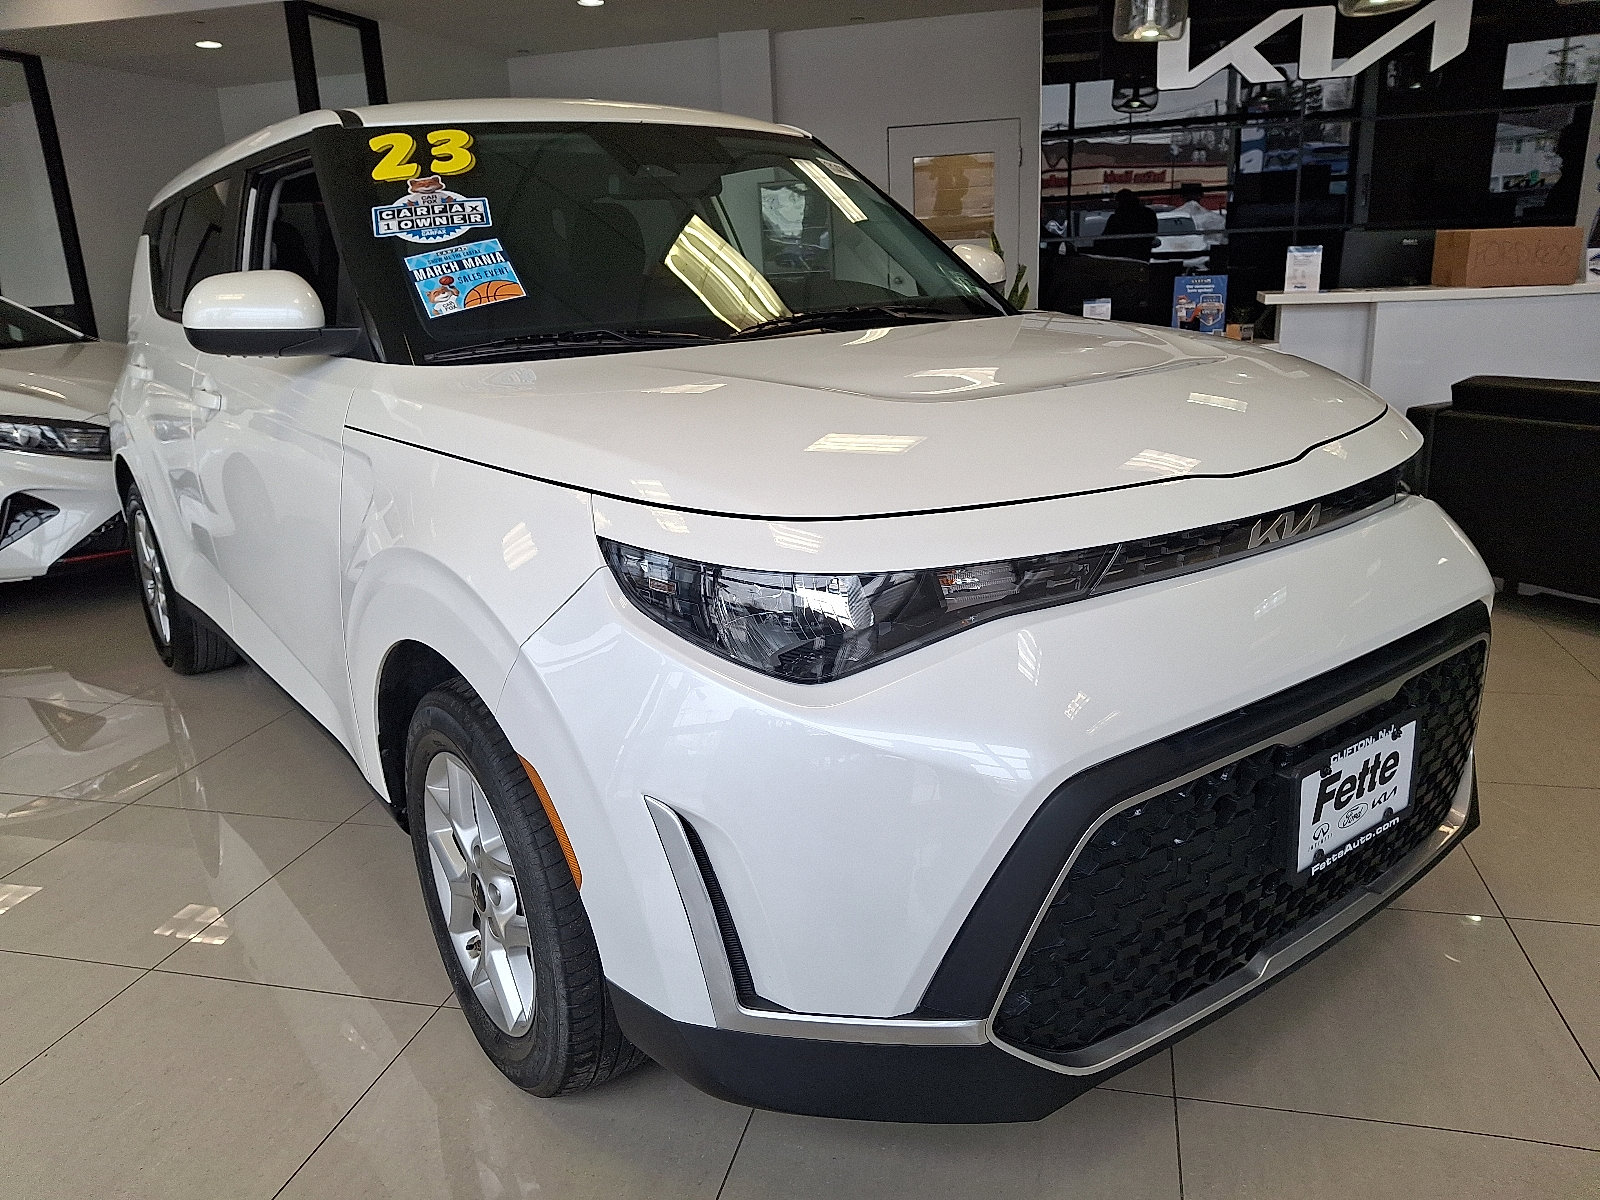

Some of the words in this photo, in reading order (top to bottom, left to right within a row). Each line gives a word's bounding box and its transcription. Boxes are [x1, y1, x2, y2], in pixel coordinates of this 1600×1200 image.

[368, 129, 477, 182] 23
[381, 204, 482, 220] CARFAX
[384, 222, 393, 231] 1
[400, 214, 482, 229] OWNER
[412, 260, 460, 282] MARCH
[461, 251, 506, 270] MANIA
[457, 272, 483, 284] SALES
[484, 266, 510, 278] EVENT
[442, 300, 455, 308] CAR
[445, 304, 458, 312] FOX
[1247, 502, 1321, 549] KIA
[1312, 750, 1400, 826] Fette
[1342, 806, 1364, 827] Ford
[1311, 816, 1400, 877] FetteAuto.com
